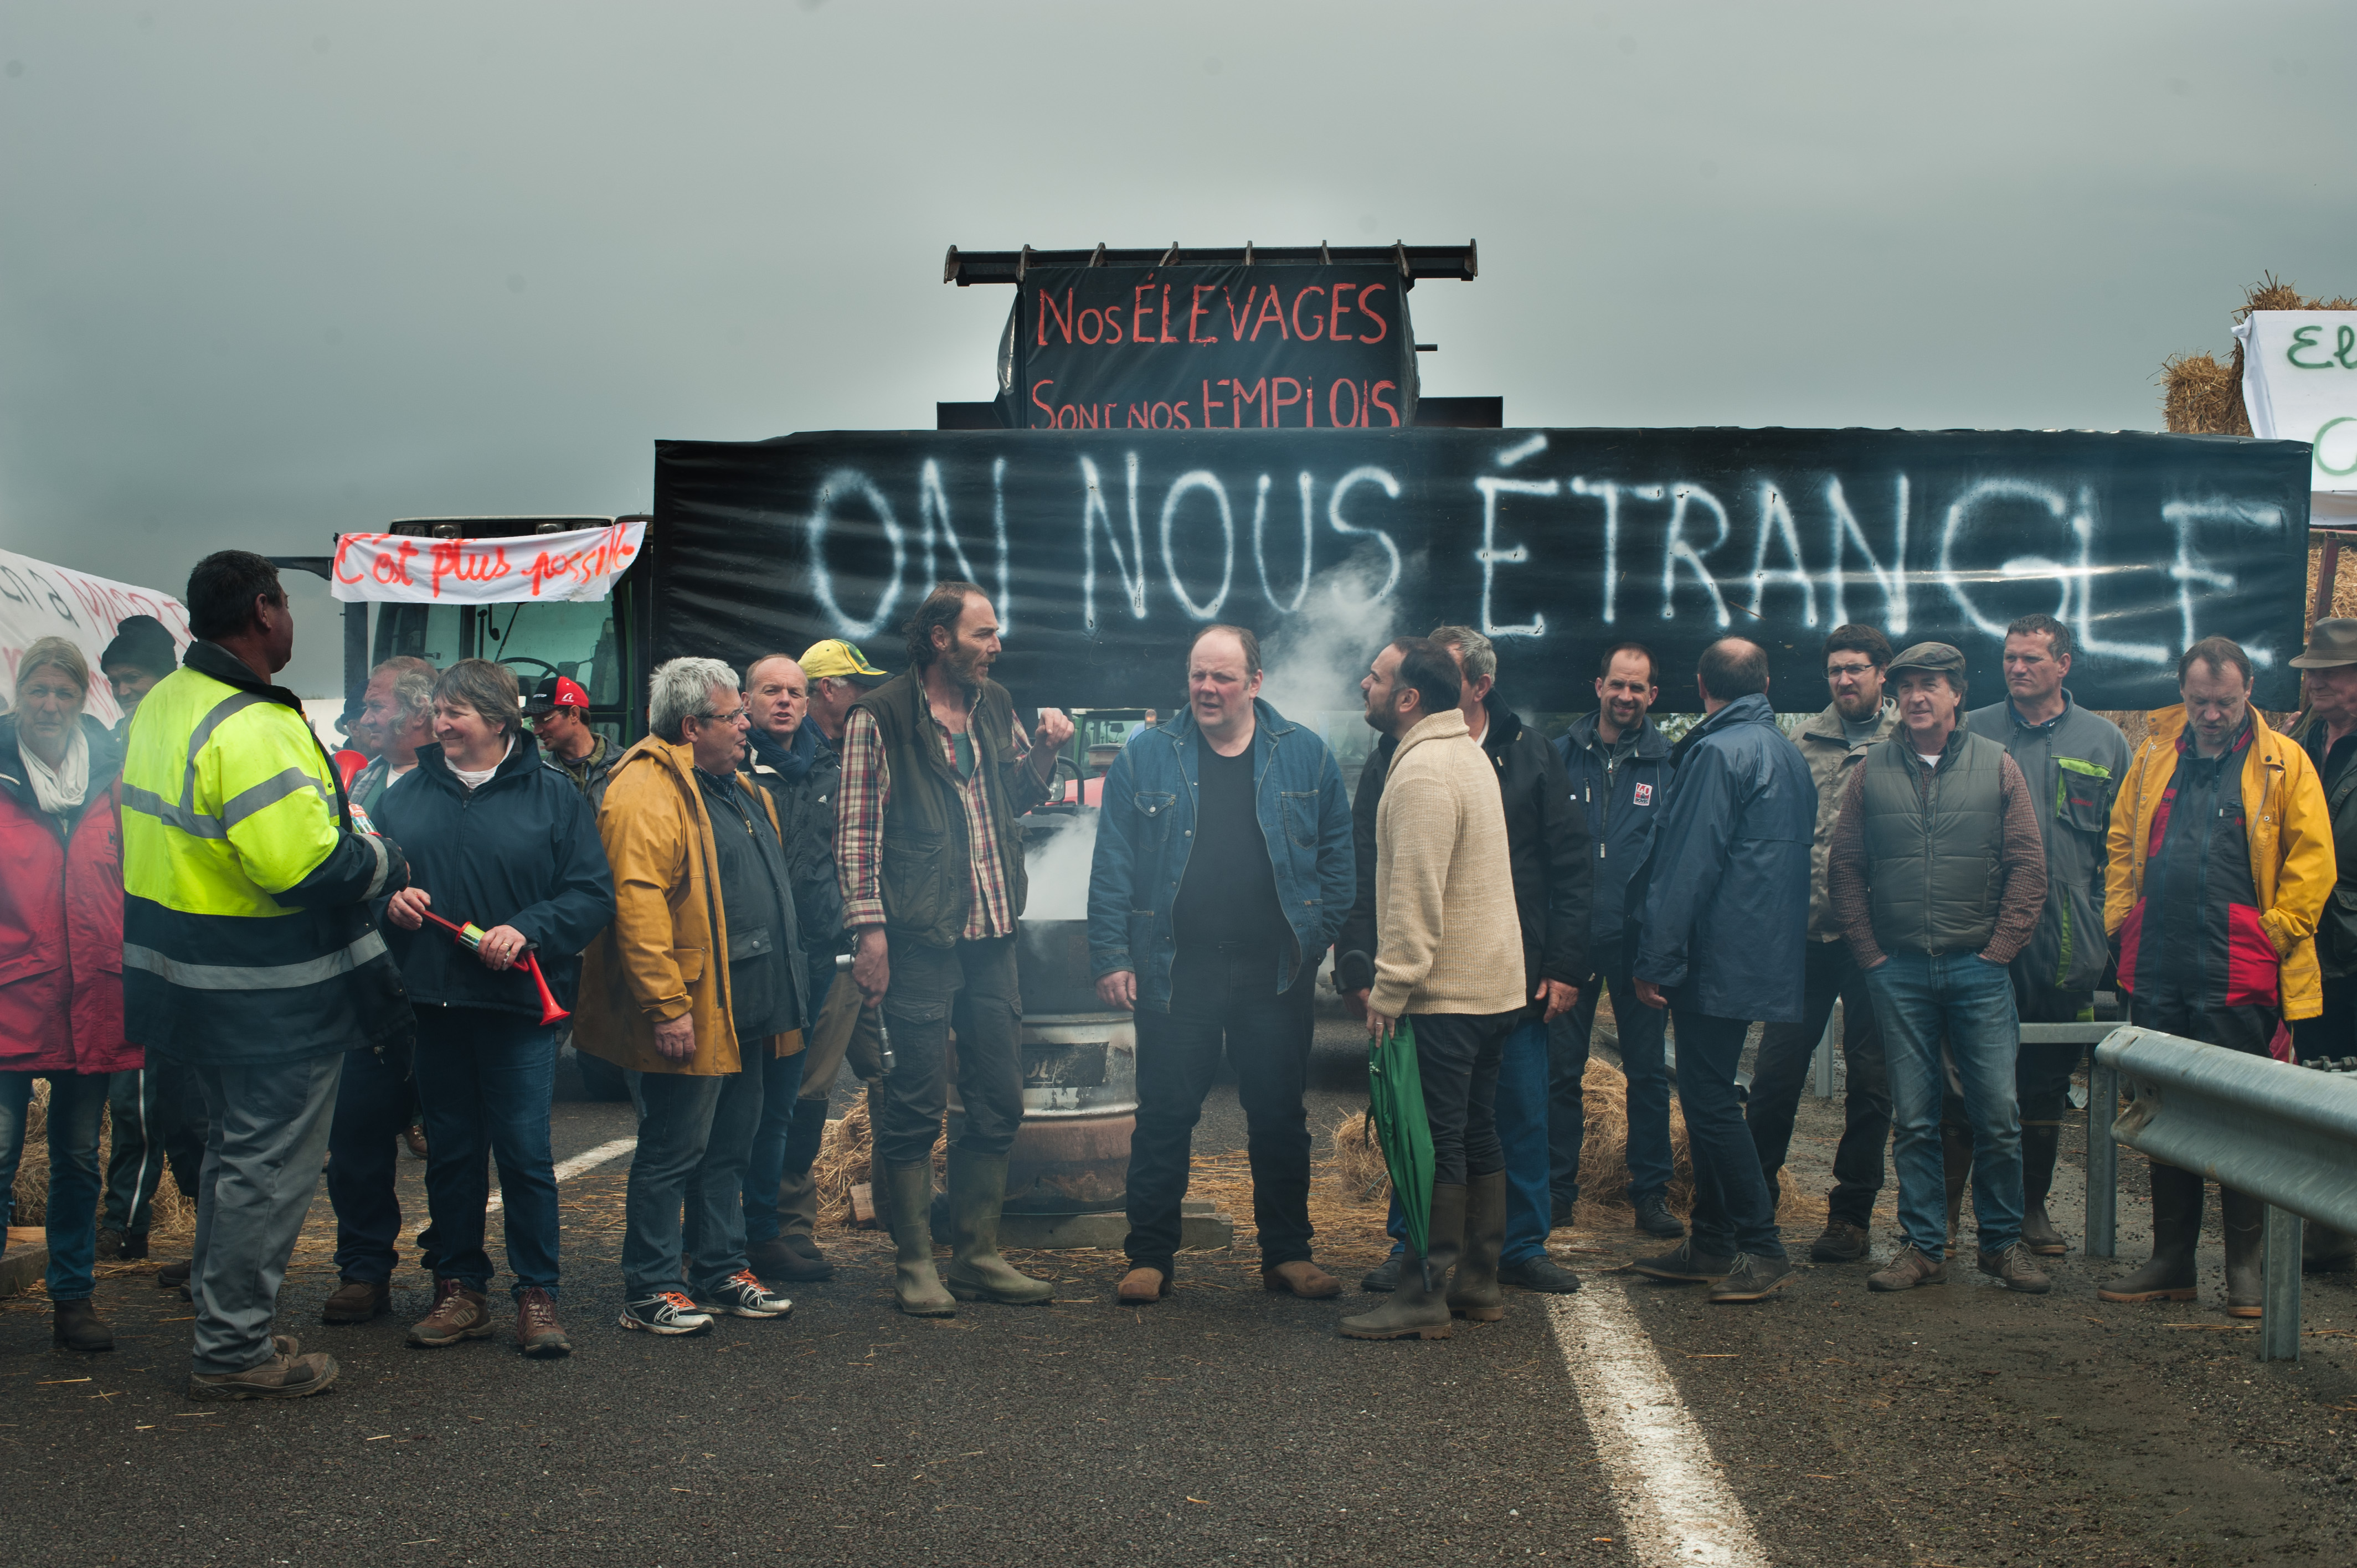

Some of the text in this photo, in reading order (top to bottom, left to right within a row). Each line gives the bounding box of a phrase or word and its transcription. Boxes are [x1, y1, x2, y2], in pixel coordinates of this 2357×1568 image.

[1133, 273, 1387, 347] ÉLEVAGES
[806, 433, 2283, 669] ON NOUS ÉTRANGLE
